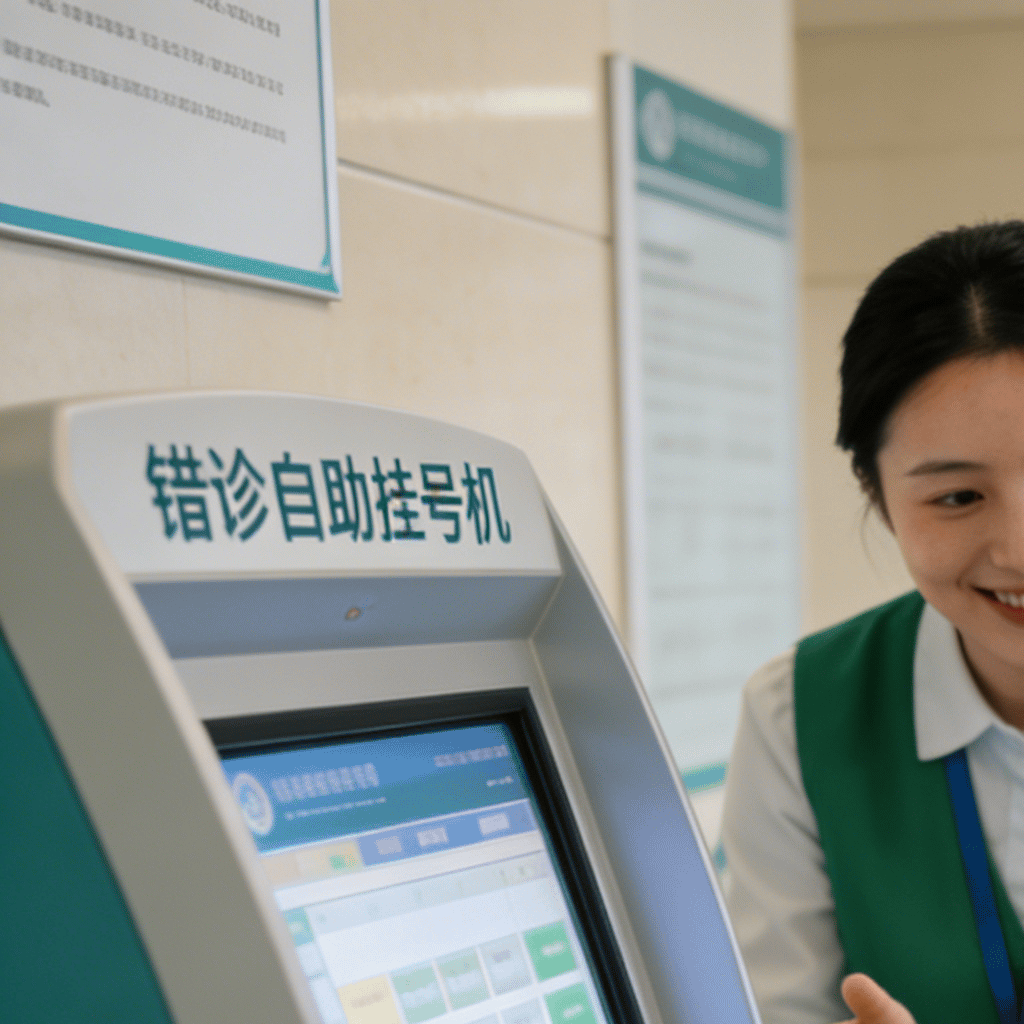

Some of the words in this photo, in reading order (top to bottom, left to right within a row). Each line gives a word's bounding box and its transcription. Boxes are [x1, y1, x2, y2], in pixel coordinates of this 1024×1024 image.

[146, 443, 512, 545] 错诊自助挂号机
